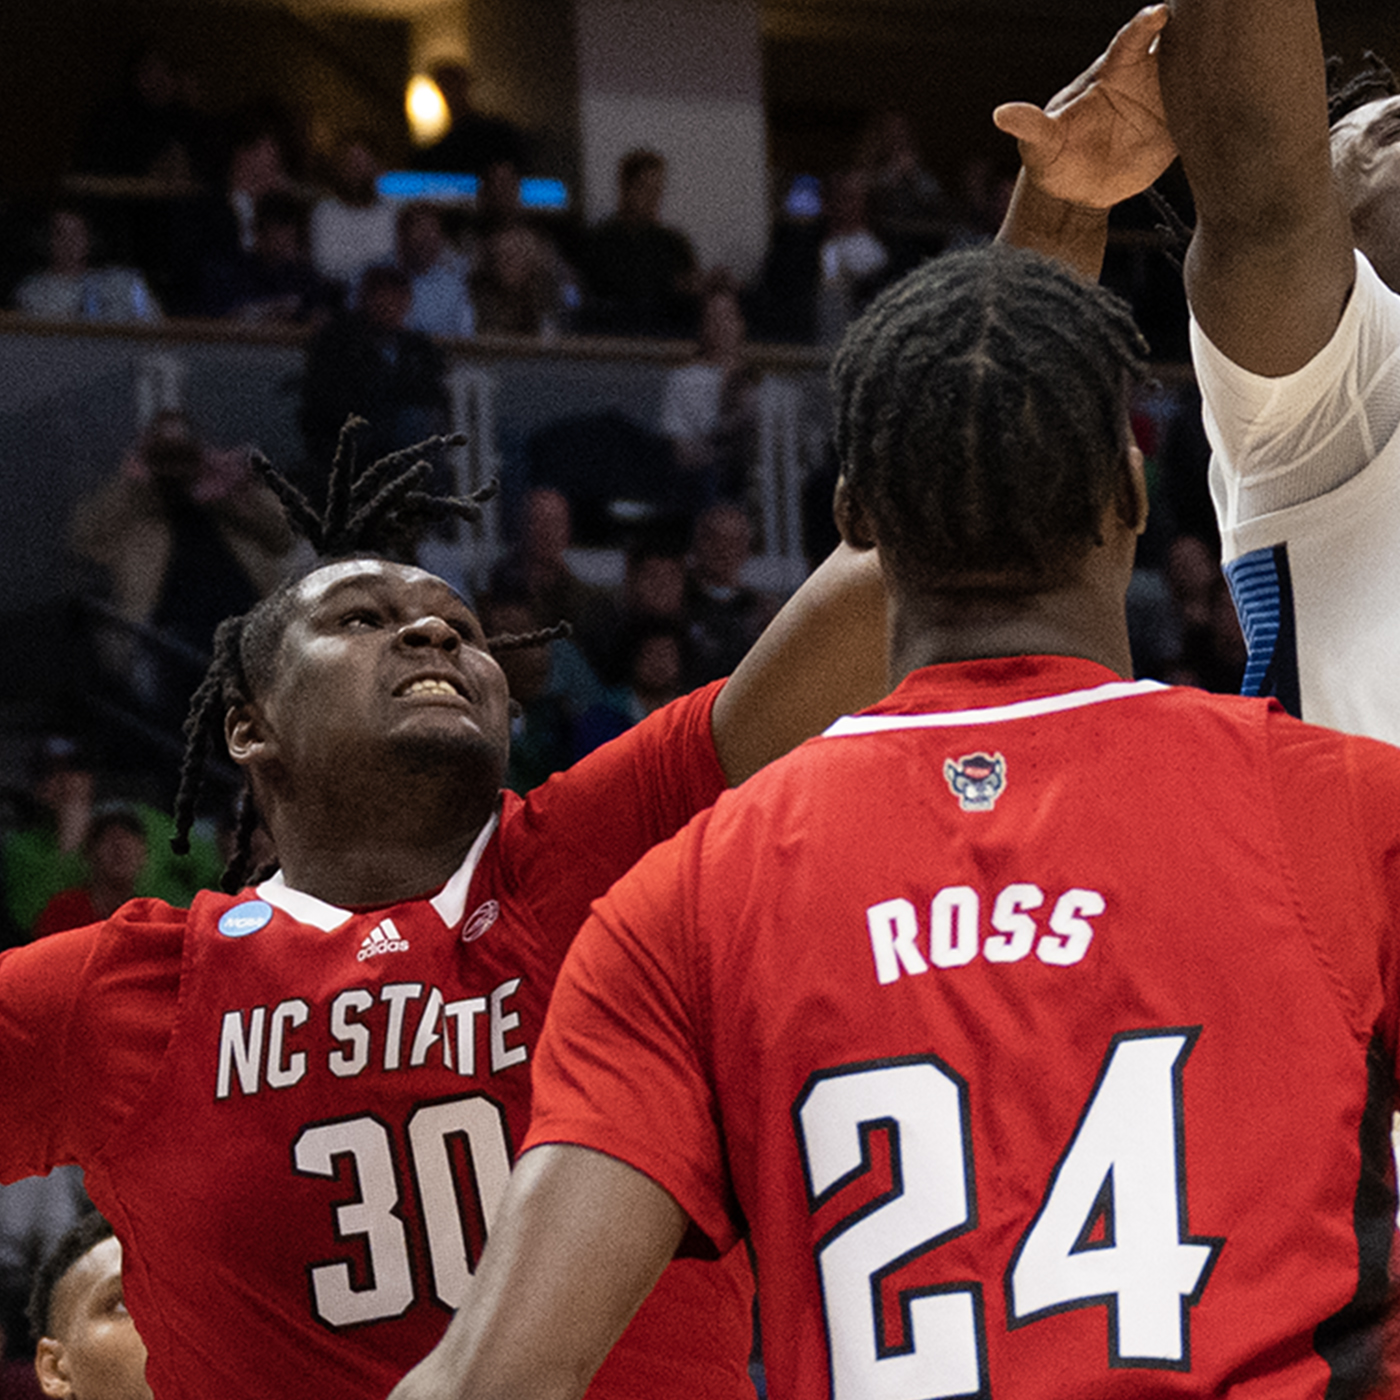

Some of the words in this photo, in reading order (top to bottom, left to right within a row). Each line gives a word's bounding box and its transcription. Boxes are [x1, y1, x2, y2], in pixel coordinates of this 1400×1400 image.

[357, 939, 410, 962] adidas
[866, 883, 1106, 986] ROSS
[214, 997, 310, 1101] NC
[328, 977, 529, 1077] STATE
[293, 1090, 514, 1333] 30
[791, 1024, 1227, 1400] 24
